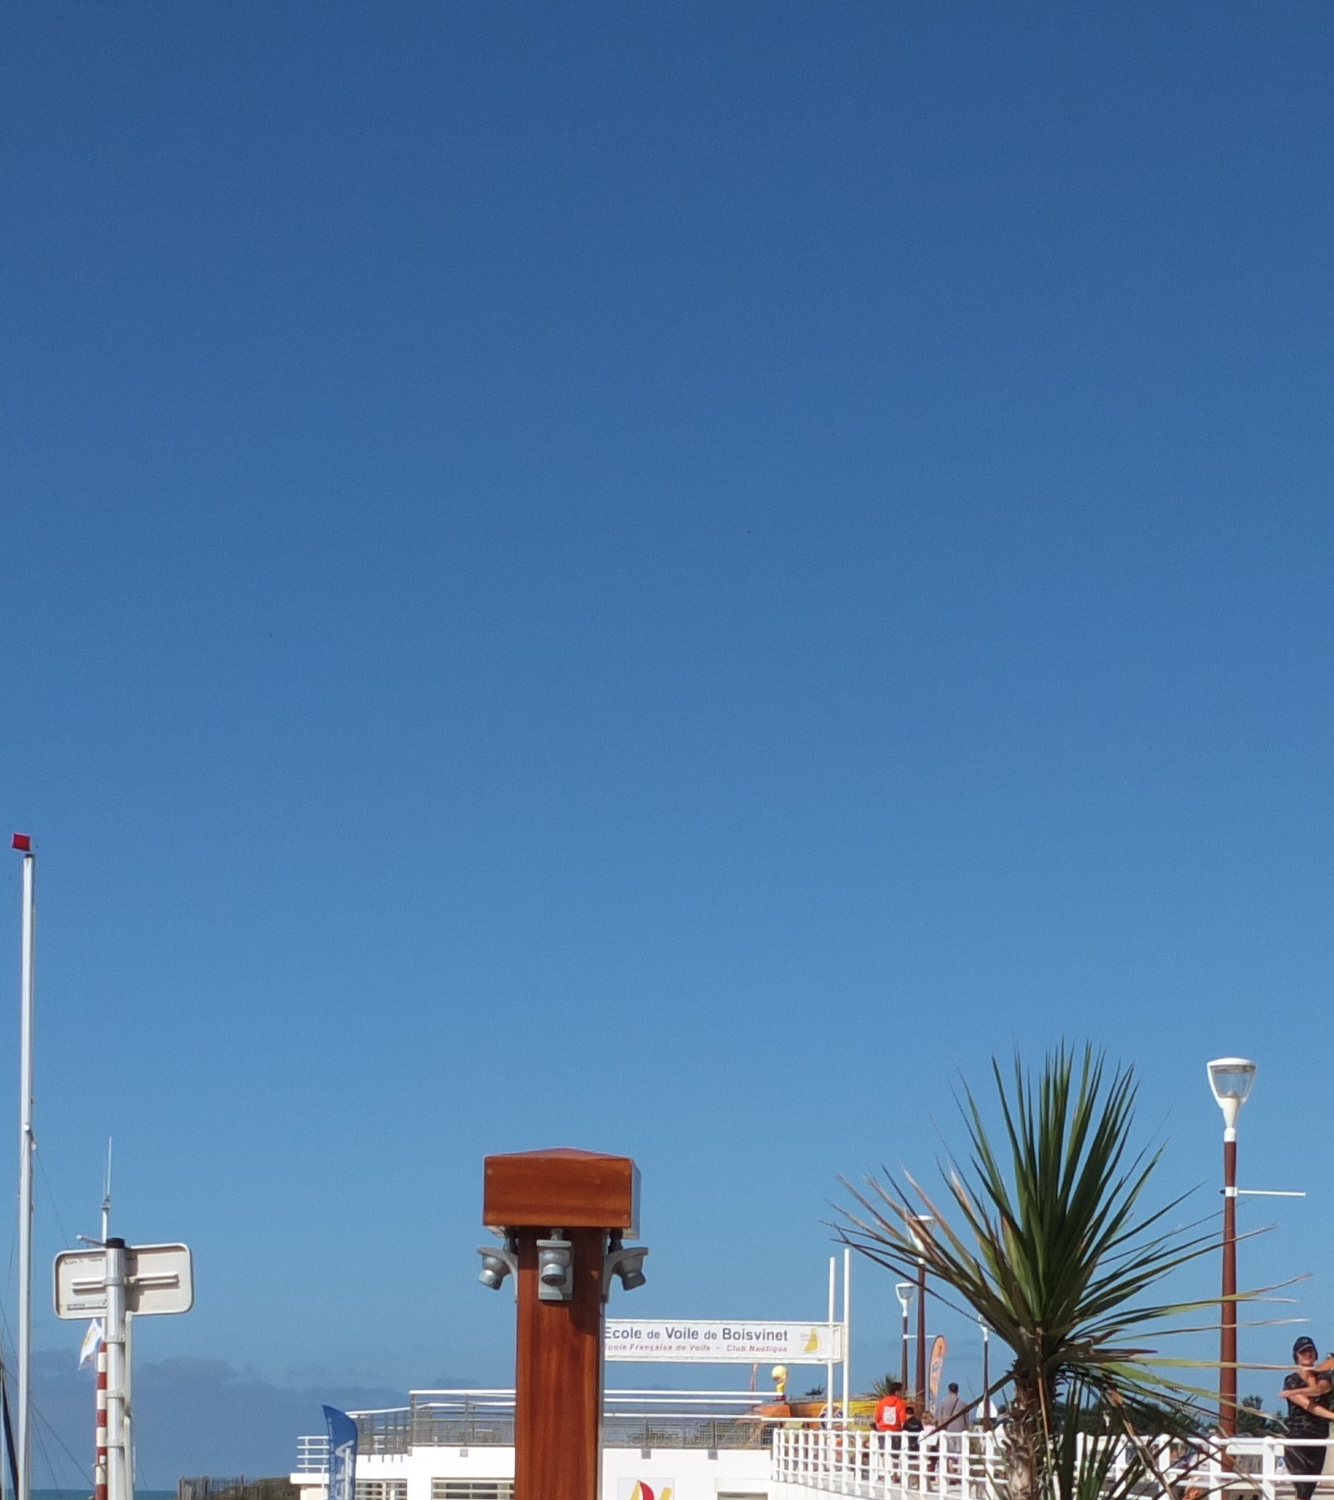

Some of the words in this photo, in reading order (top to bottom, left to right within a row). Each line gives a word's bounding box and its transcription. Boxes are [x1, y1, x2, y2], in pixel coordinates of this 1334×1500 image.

[647, 1330, 660, 1340] de
[665, 1327, 699, 1340] Voile
[704, 1330, 718, 1341] de
[722, 1327, 789, 1342] Boisvinet
[726, 1344, 747, 1352] Club
